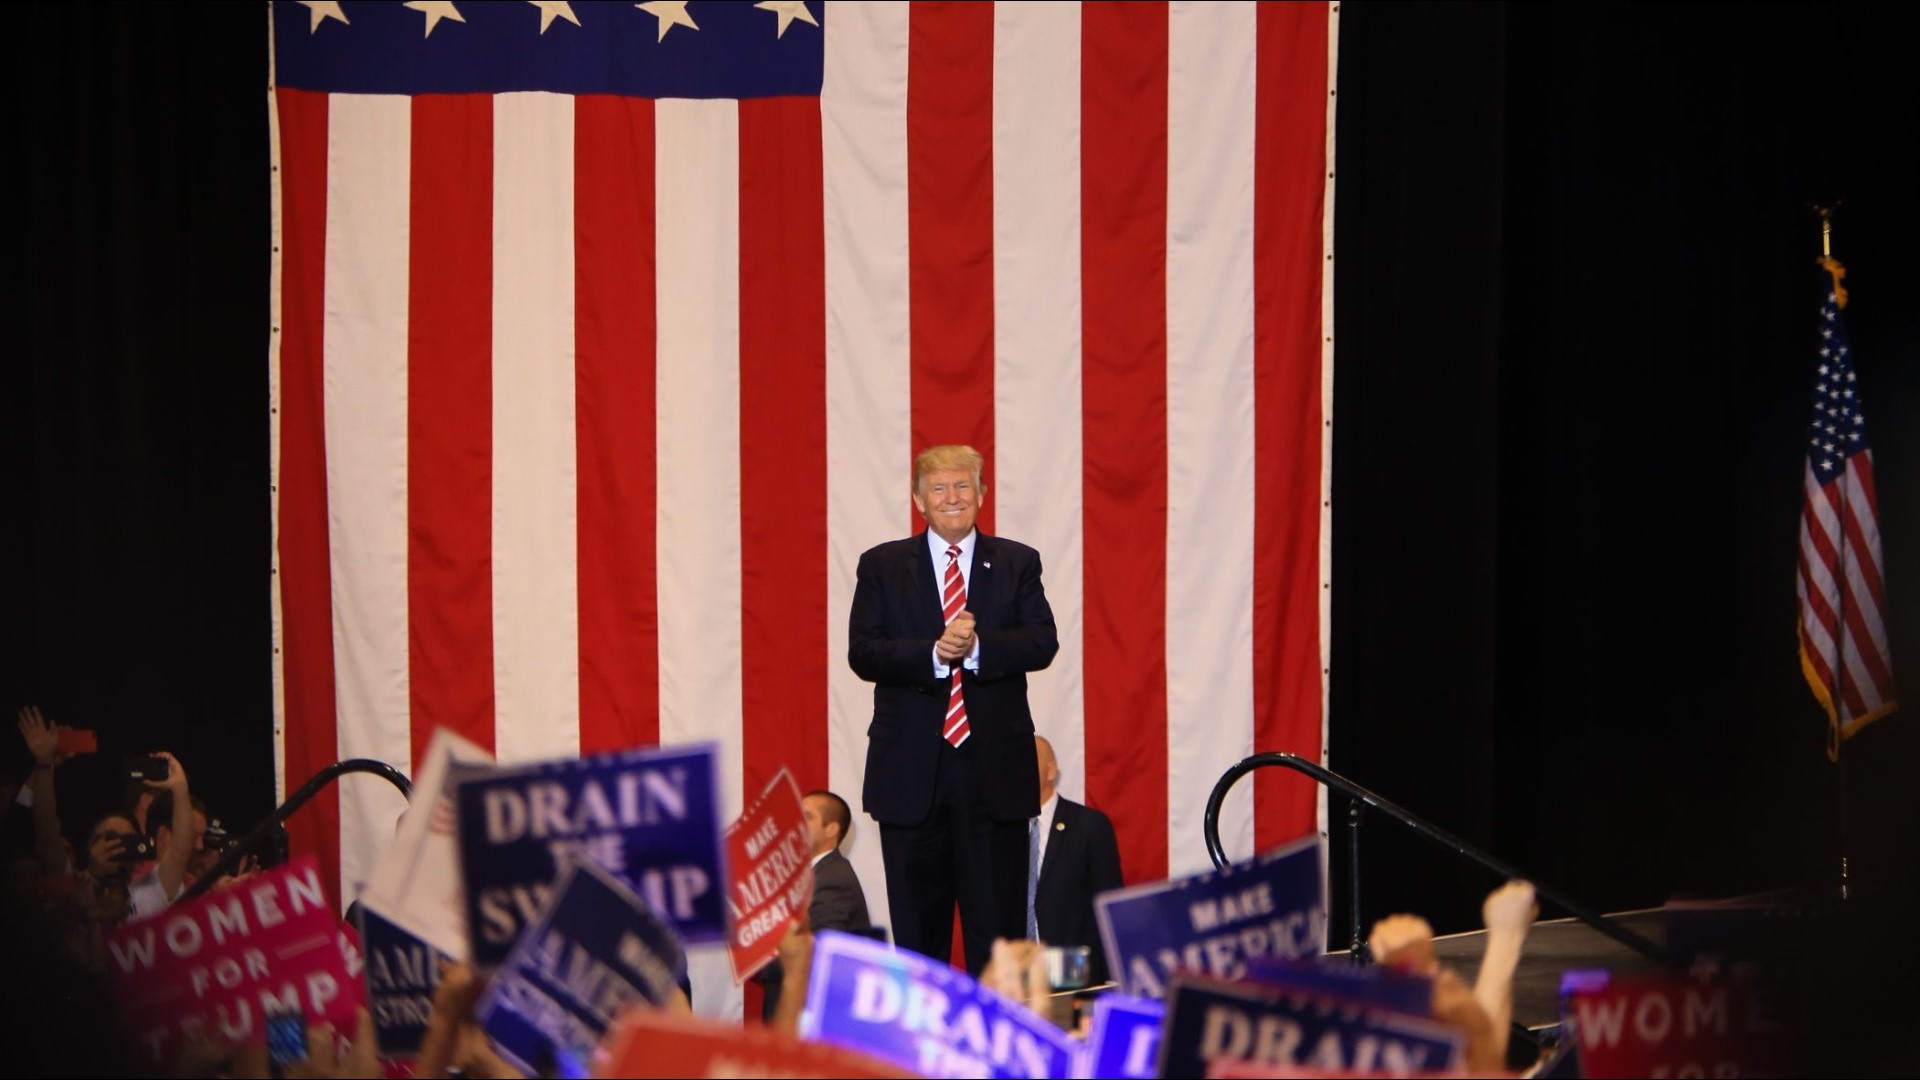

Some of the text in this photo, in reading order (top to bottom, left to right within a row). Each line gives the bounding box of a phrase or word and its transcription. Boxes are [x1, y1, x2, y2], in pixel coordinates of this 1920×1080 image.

[483, 764, 689, 846] DRAIN
[744, 815, 780, 861] MAKE
[108, 865, 328, 976] WOMEN
[736, 896, 790, 948] GREAT
[1188, 880, 1275, 934] MAKE
[190, 945, 272, 998] FOR
[850, 965, 1052, 1079] DRAIN
[1197, 1001, 1434, 1078] DRAIN
